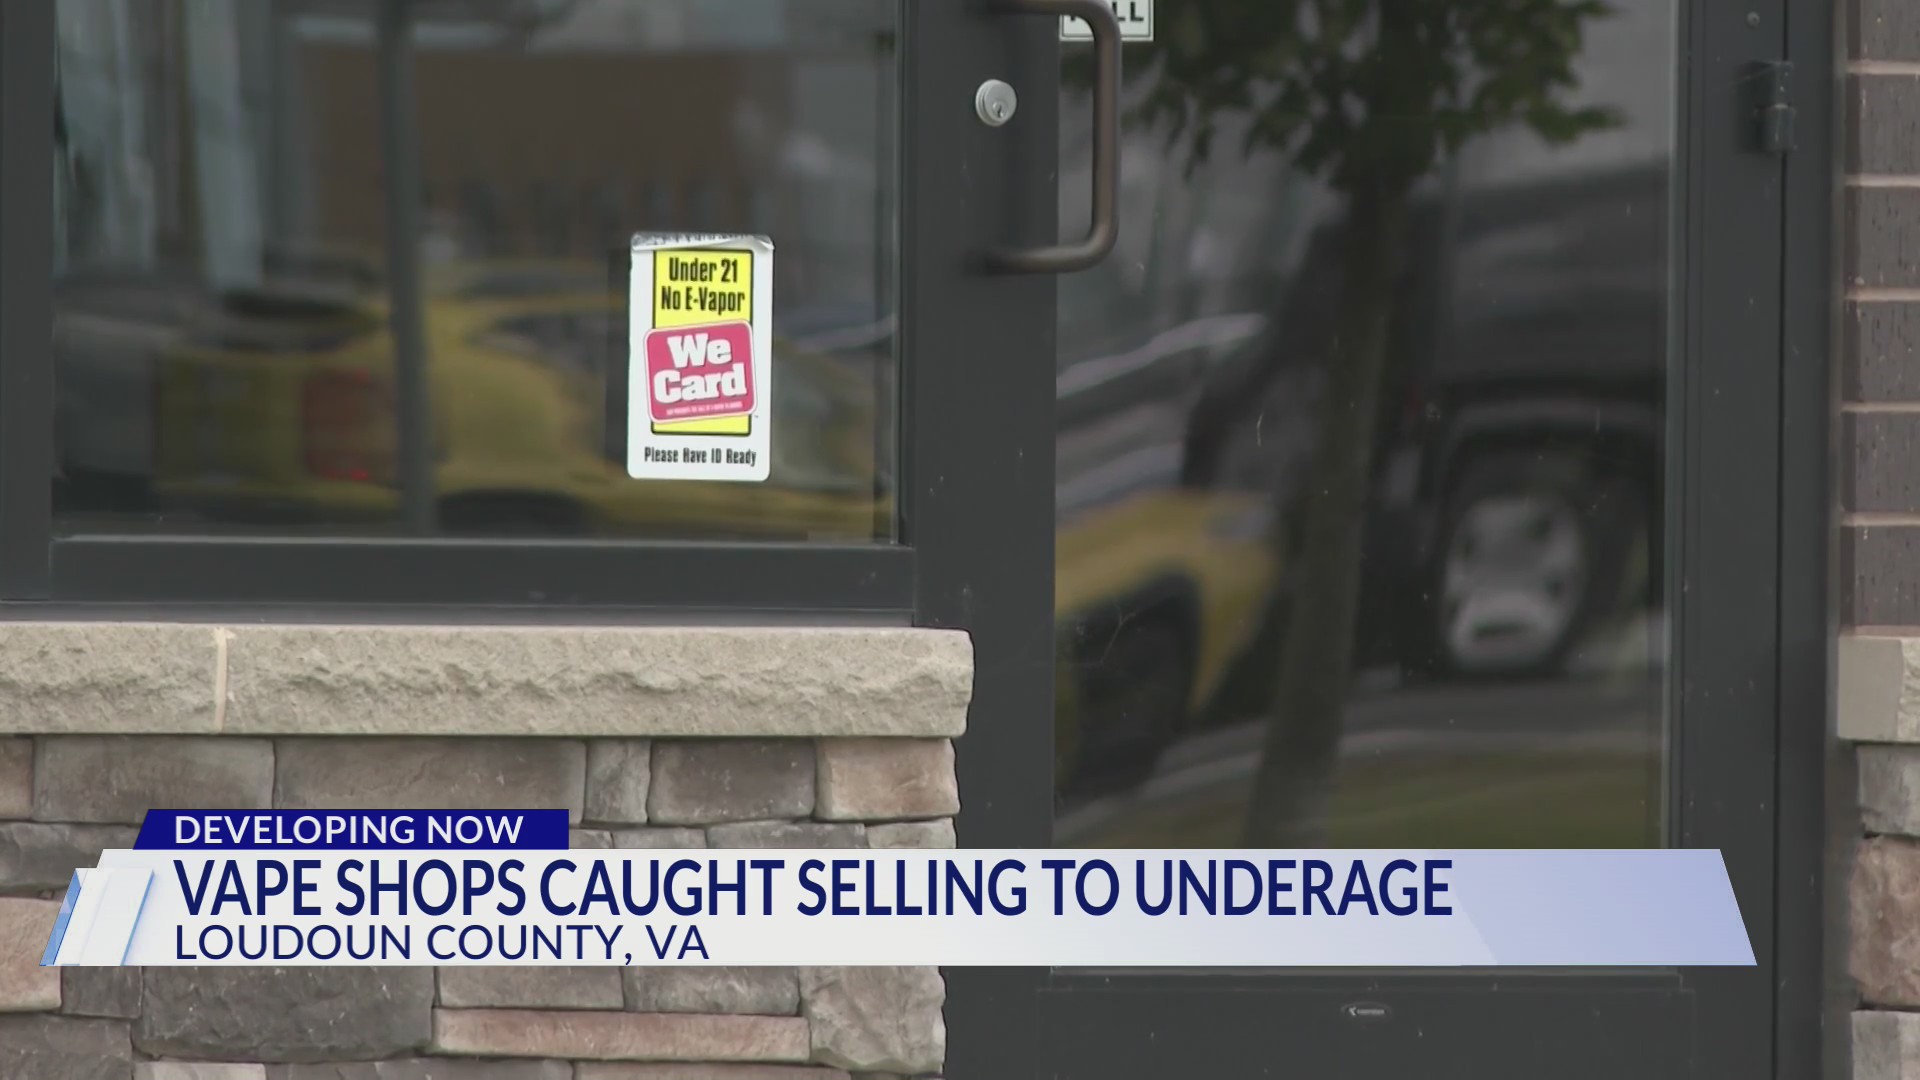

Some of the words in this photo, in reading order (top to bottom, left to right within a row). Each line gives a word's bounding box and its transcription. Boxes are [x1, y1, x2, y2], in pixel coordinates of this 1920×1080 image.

[669, 257, 717, 282] Under
[721, 258, 738, 283] 21
[661, 285, 681, 310] No
[685, 286, 745, 316] E-Vapor
[667, 332, 732, 368] We
[653, 362, 748, 404] Card
[644, 446, 679, 463] Please
[683, 447, 708, 464] Have
[711, 448, 722, 464] ID
[726, 448, 757, 467] Ready
